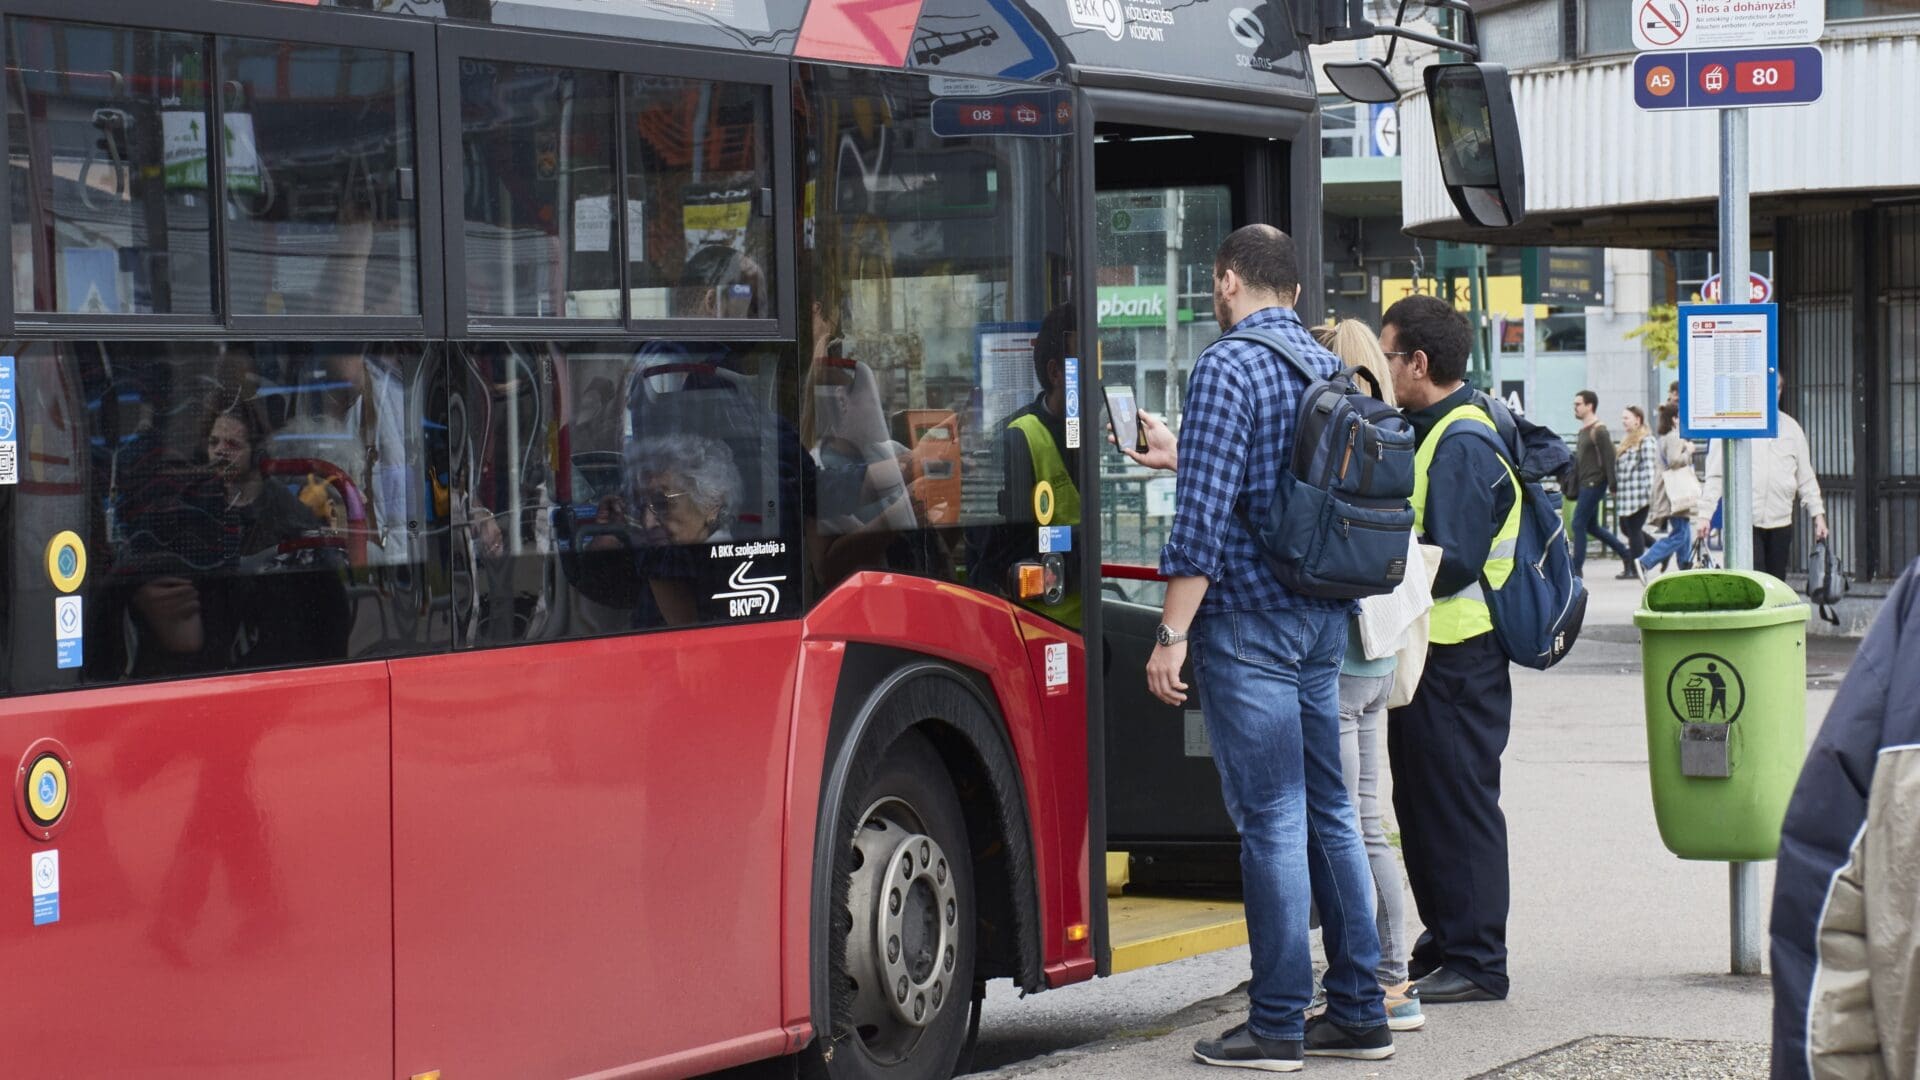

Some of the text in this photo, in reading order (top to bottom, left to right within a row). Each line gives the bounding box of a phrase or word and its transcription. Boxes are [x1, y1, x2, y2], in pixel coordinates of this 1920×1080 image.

[1075, 0, 1099, 16] BKK
[1124, 4, 1175, 25] KÖZLEKEDÉSI
[1696, 4, 1720, 14] tilos
[1733, 0, 1796, 13] dohányzás!
[1129, 23, 1165, 42] KÖZPONT
[1235, 54, 1273, 70] SOLARIS
[1650, 75, 1671, 87] A5
[1752, 68, 1778, 85] 80
[710, 541, 786, 559] A BKK szolgáltatója a
[729, 598, 752, 617] BKV
